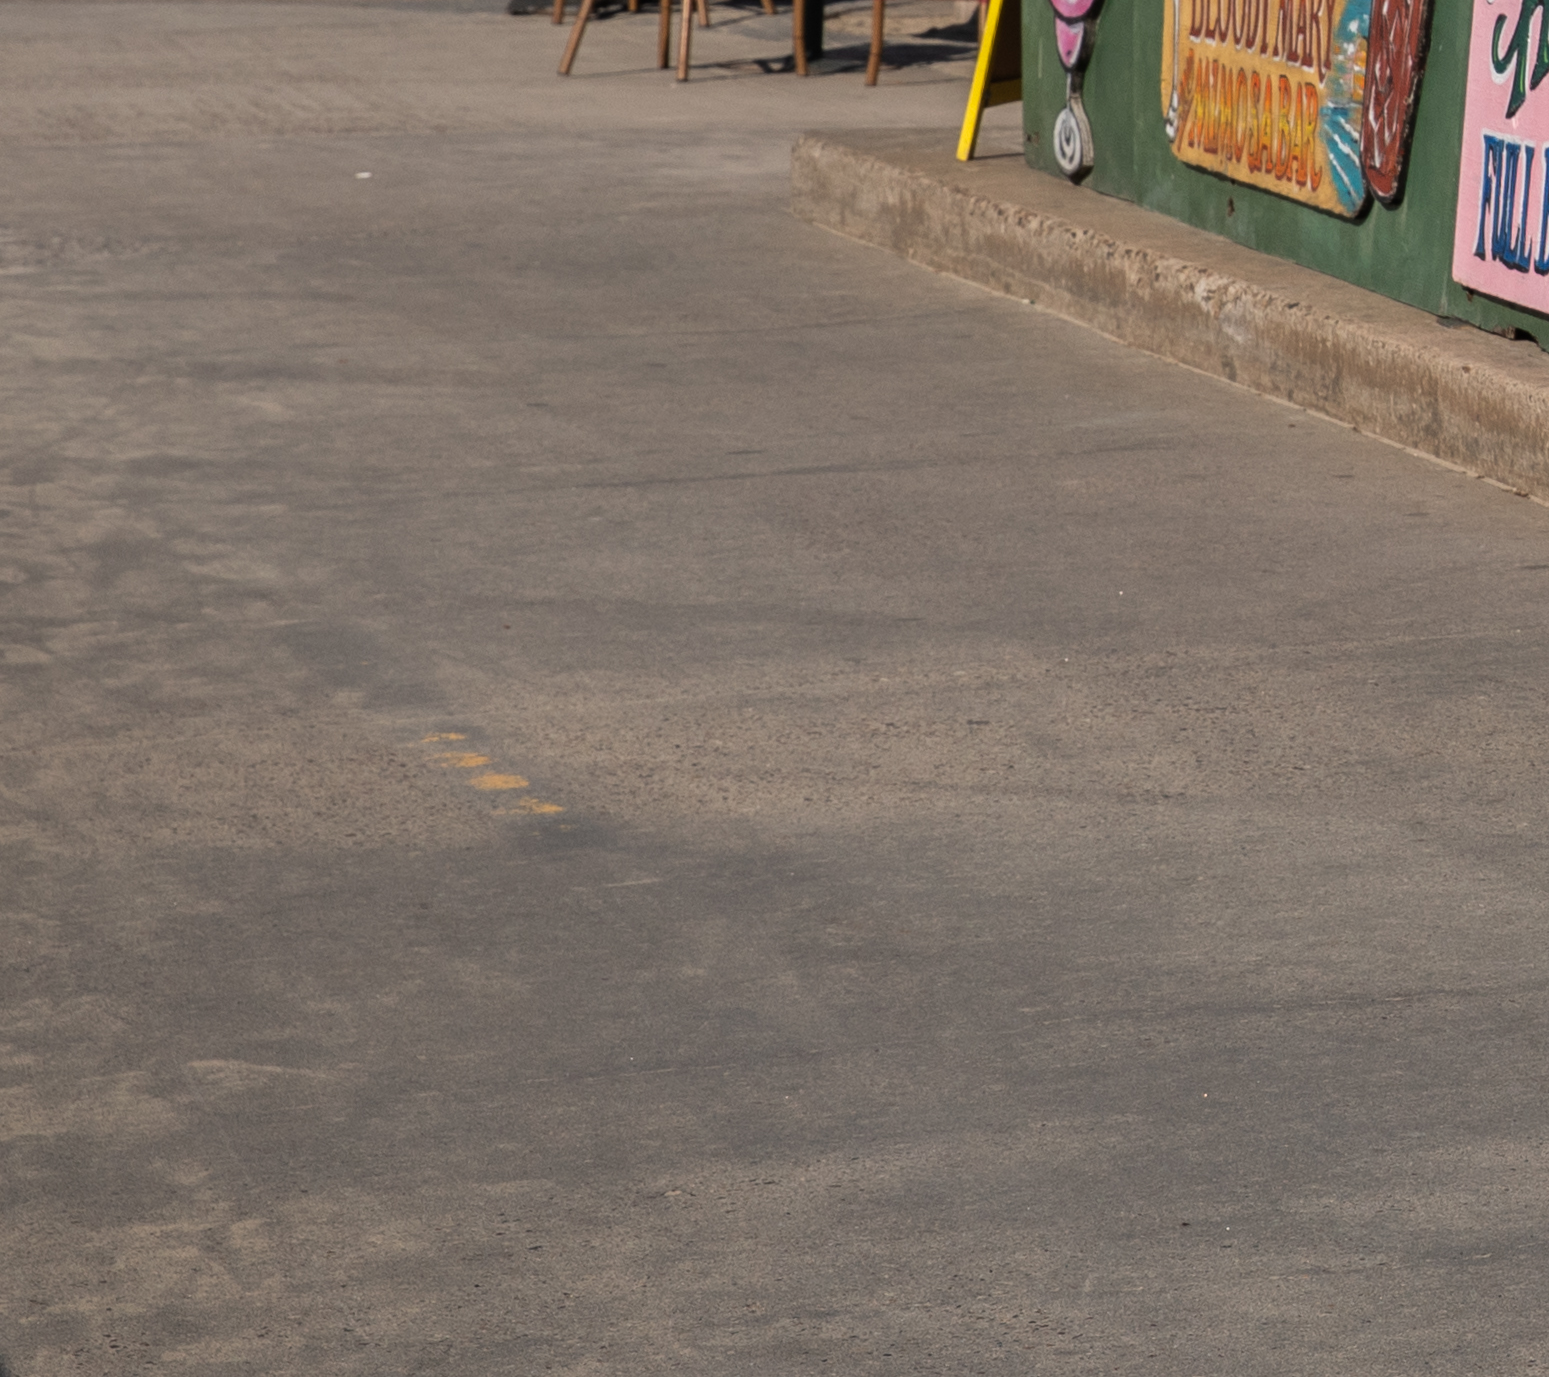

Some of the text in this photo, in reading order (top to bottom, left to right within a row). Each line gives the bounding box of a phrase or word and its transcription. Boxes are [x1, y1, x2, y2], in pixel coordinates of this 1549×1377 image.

[1186, 55, 1274, 181] MIMOSA
[1272, 73, 1322, 192] BAR
[1475, 129, 1535, 274] FULL
